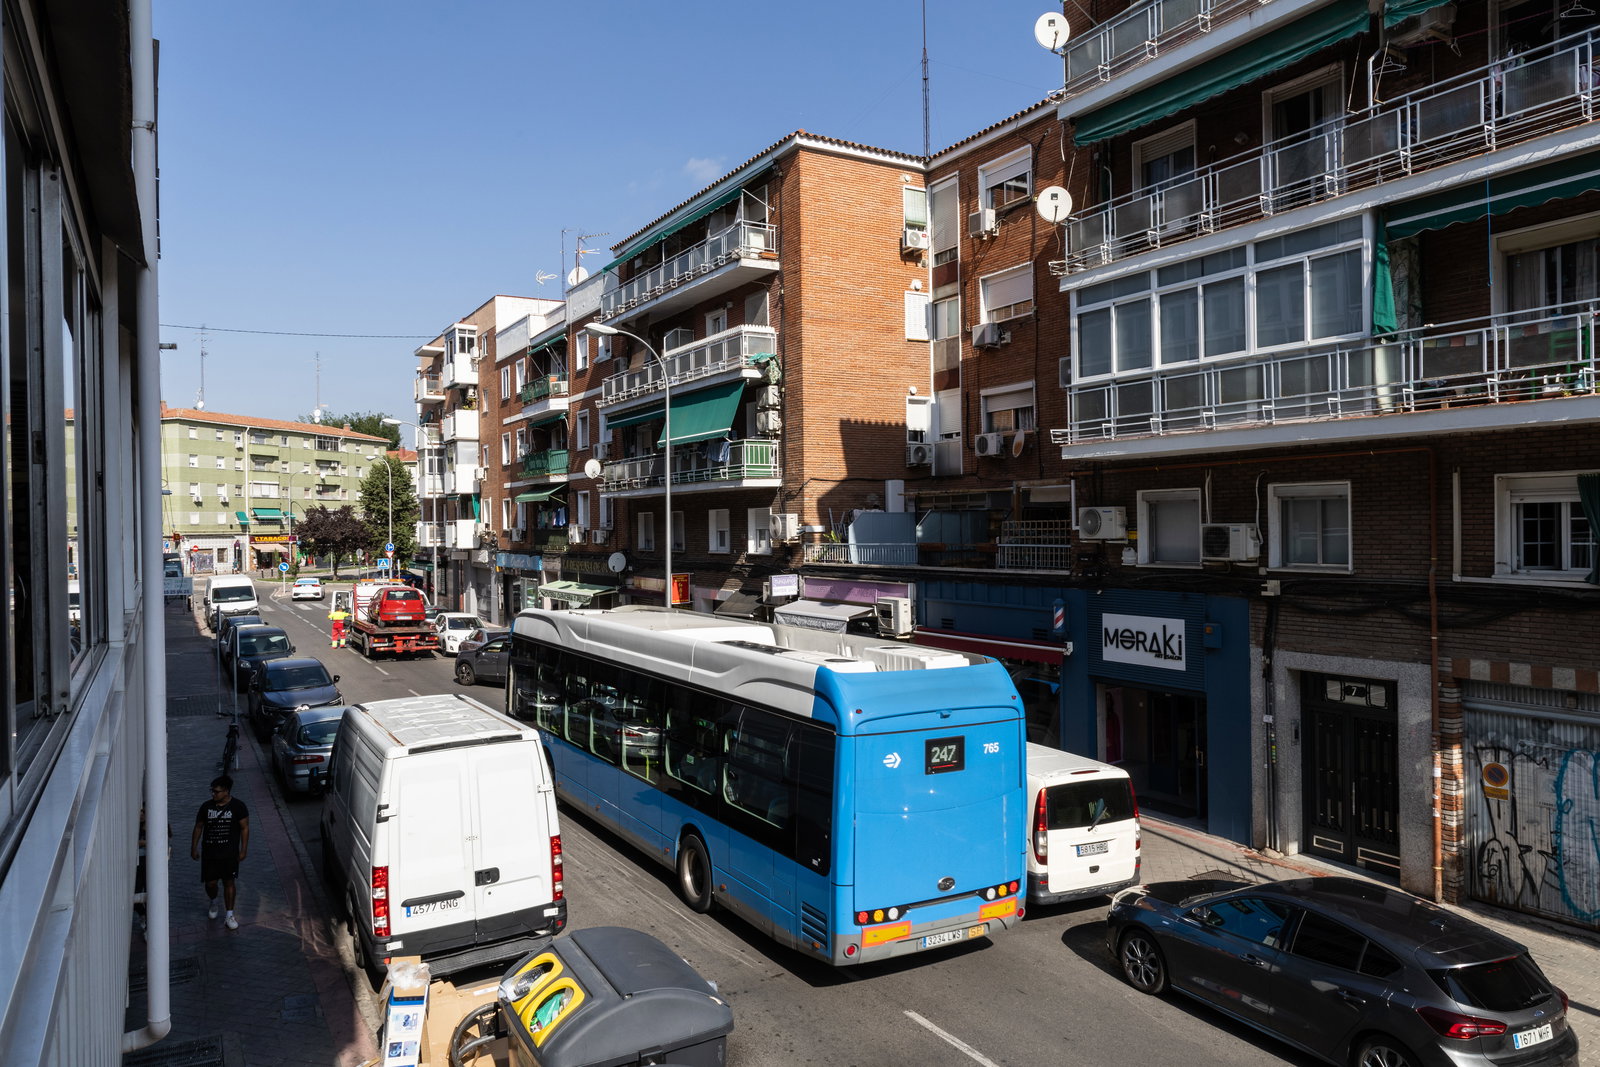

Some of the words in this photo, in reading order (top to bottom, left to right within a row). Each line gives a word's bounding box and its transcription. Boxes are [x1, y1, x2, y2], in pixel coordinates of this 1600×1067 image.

[931, 744, 957, 763] 247
[983, 742, 1000, 754] 765
[1080, 844, 1096, 854] 5815
[413, 902, 438, 914] 4577
[440, 898, 459, 910] GNG
[928, 935, 946, 946] 3234
[947, 929, 961, 941] LWS
[1519, 1030, 1537, 1046] 1671
